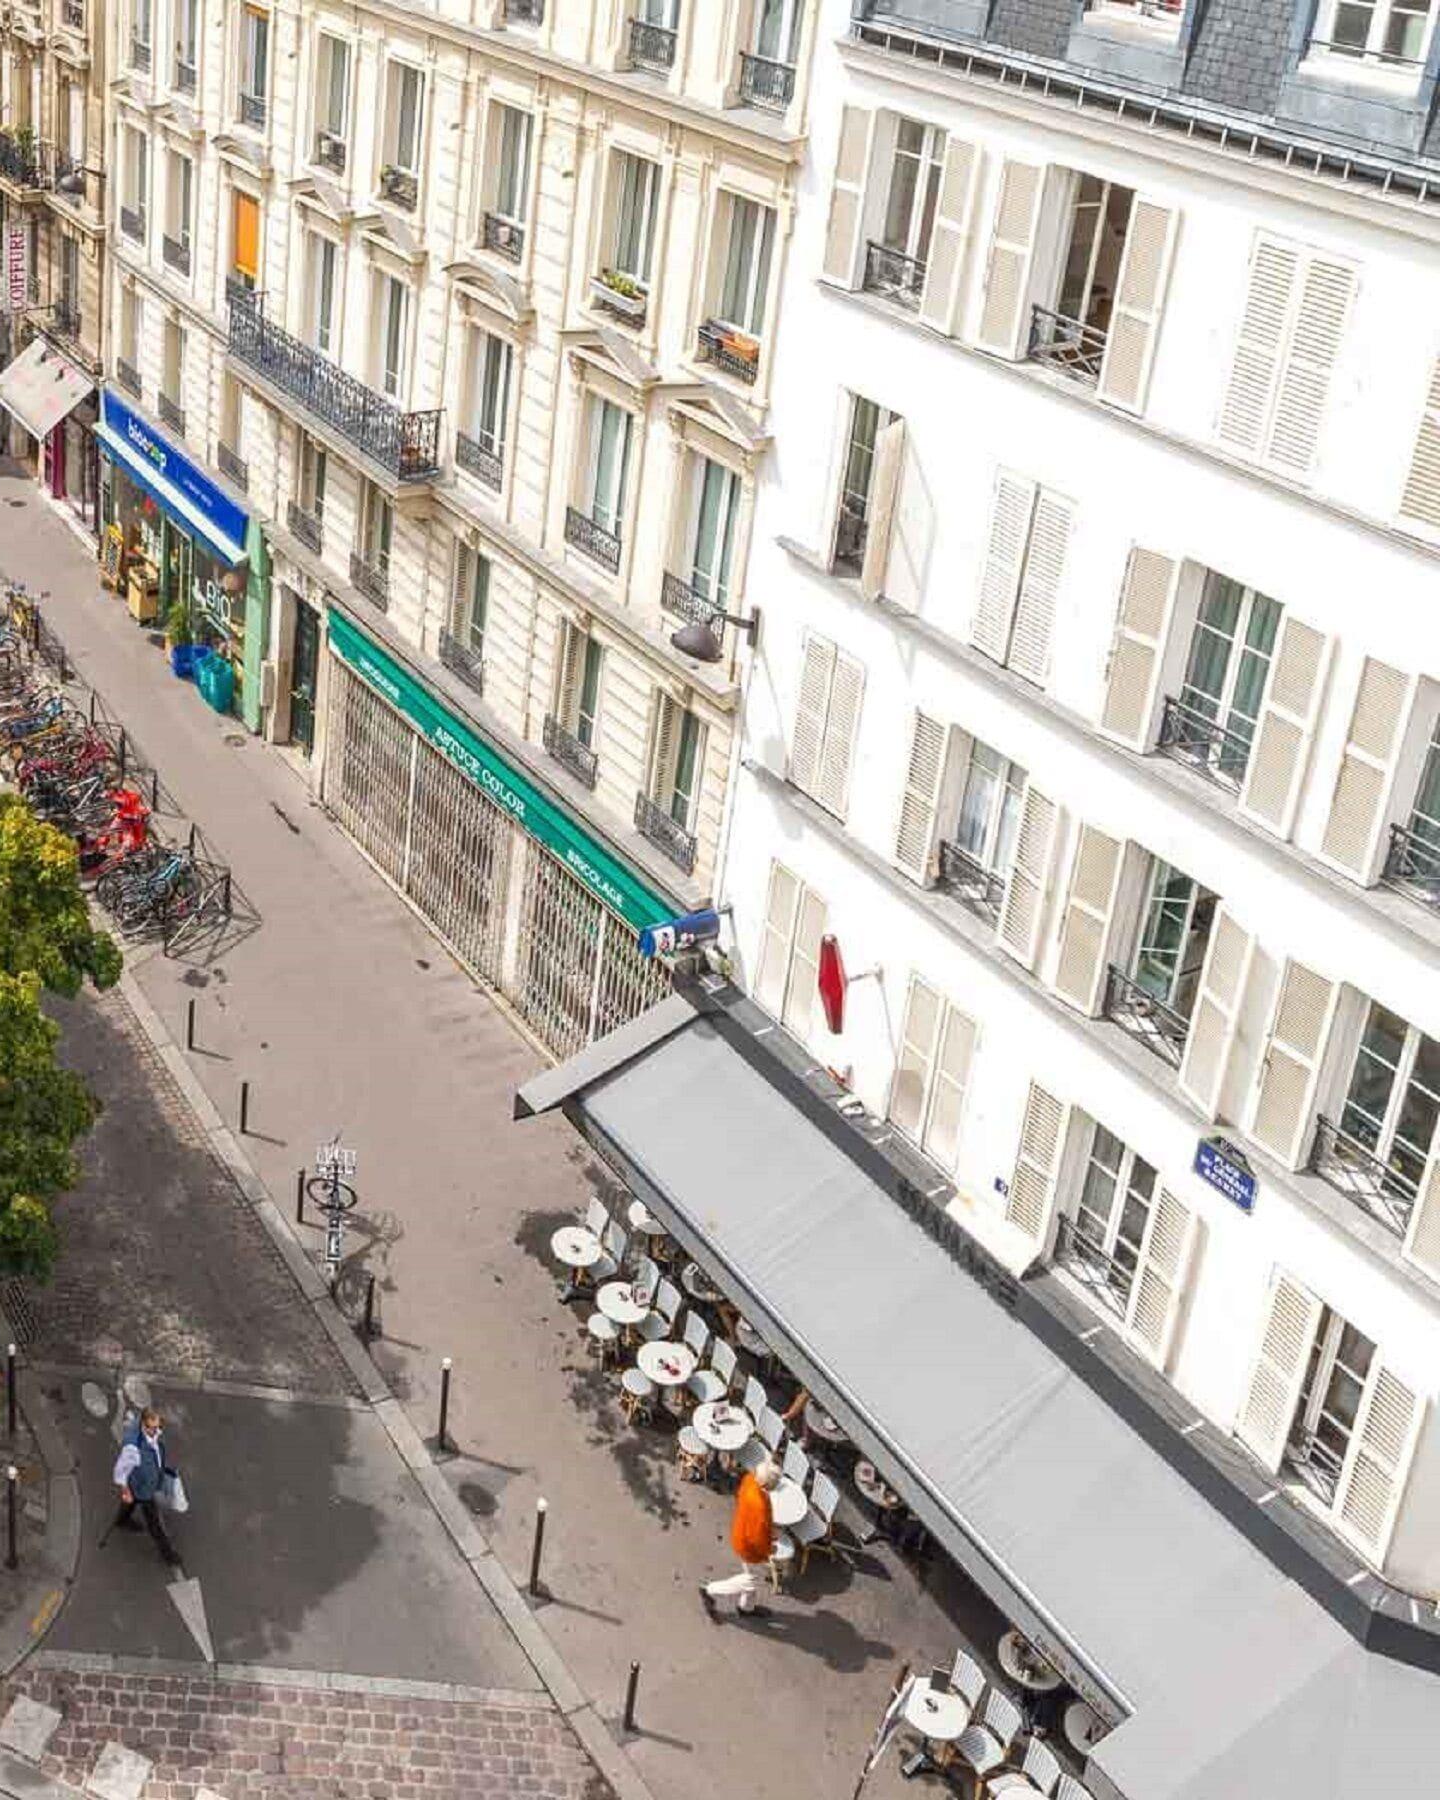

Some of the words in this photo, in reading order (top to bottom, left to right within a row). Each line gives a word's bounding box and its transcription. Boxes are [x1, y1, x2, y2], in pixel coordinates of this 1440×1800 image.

[9, 229, 26, 311] COIFFURE
[482, 769, 526, 818] COLOR
[566, 849, 625, 907] BRICOLAGE
